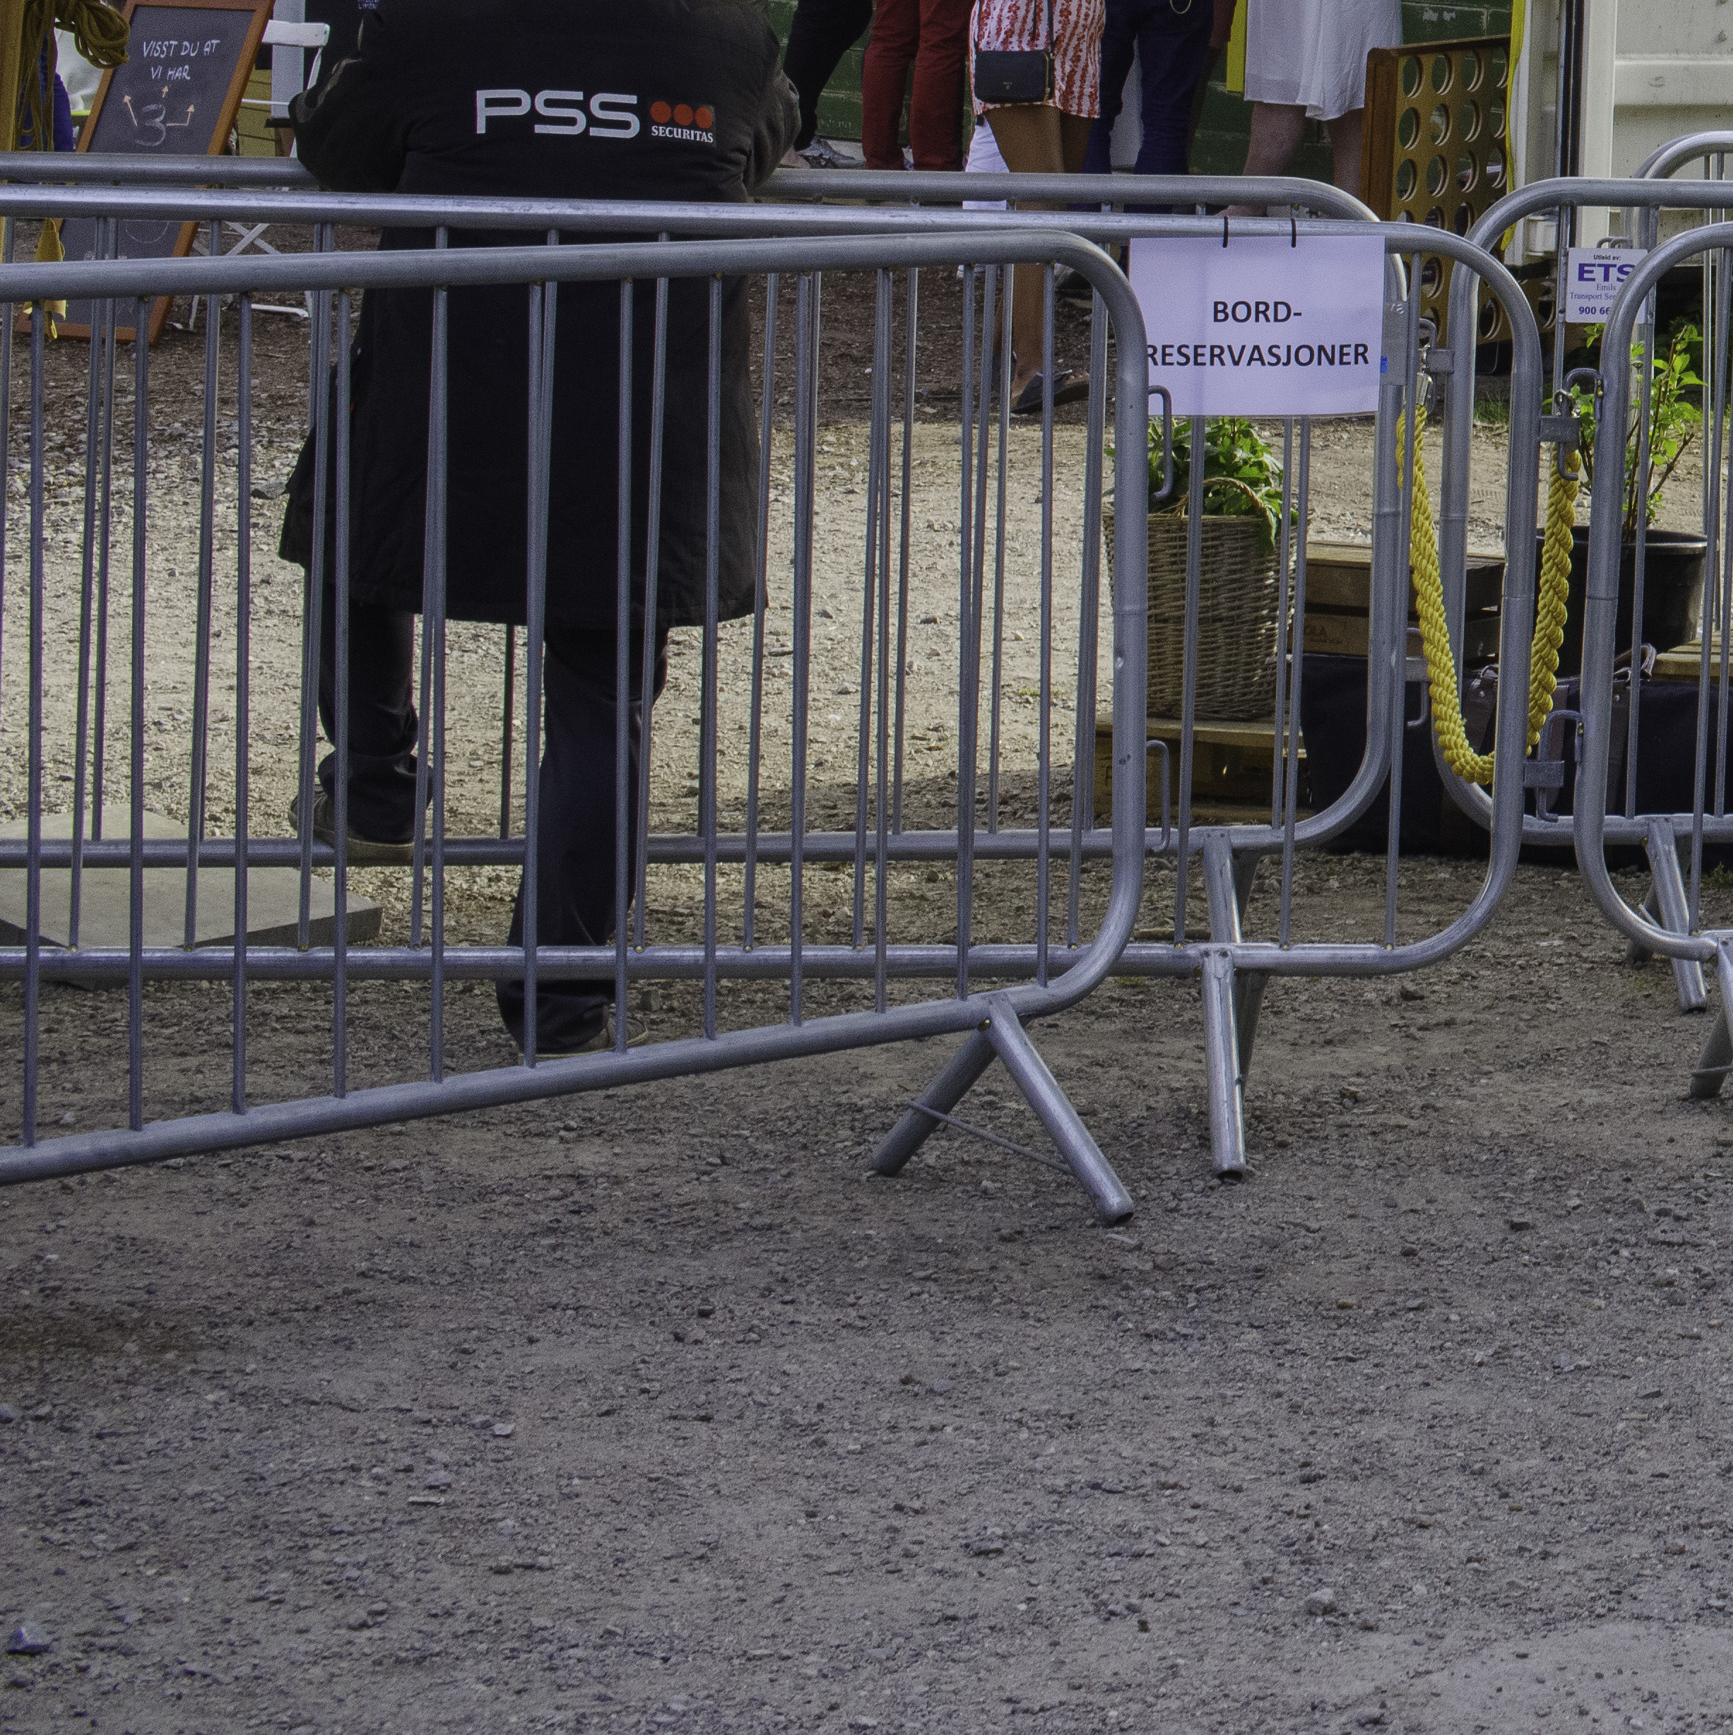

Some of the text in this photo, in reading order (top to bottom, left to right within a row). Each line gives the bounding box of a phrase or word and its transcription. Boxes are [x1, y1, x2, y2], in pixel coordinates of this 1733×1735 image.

[143, 39, 221, 58] VISST DU AT
[151, 65, 191, 80] VI HAR
[476, 88, 640, 139] PSS
[651, 125, 714, 143] SECURITAS
[1578, 263, 1635, 282] ETS
[1570, 291, 1616, 301] Transport Se
[1596, 283, 1616, 291] Emils
[1213, 301, 1302, 323] BORD-
[1578, 306, 1596, 315] 900
[1147, 344, 1369, 366] RESERVASJONER
